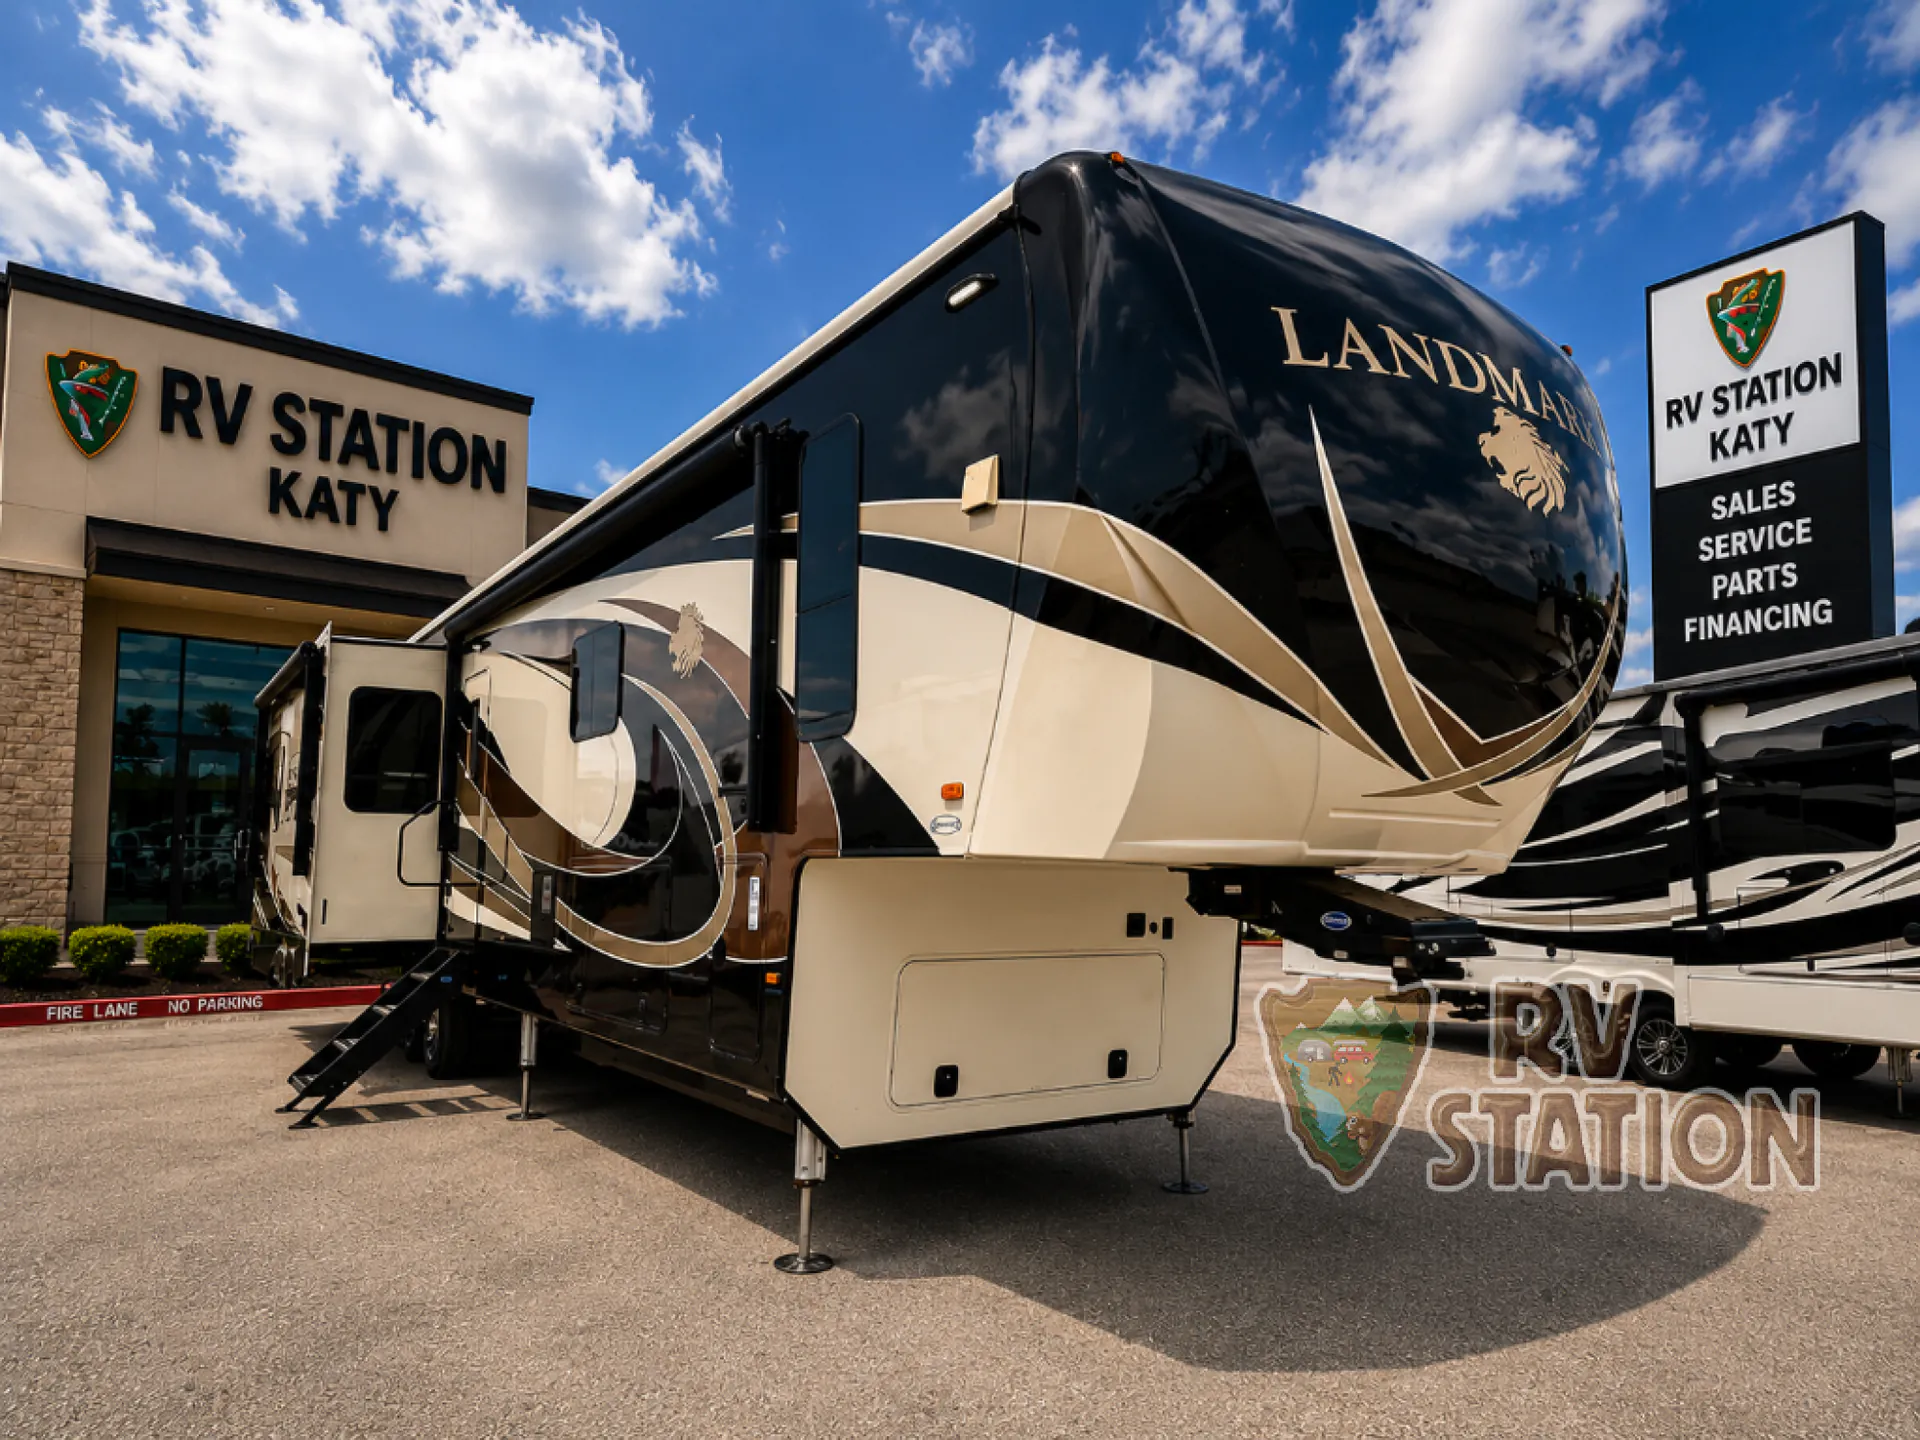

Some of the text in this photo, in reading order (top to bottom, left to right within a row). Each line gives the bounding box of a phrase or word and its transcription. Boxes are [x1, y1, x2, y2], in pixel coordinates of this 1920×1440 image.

[1270, 306, 1602, 458] LANDMARK
[1666, 352, 1843, 429] RV STATION
[159, 366, 507, 494] RV STATION
[1708, 412, 1796, 462] KATY
[268, 466, 400, 532] KATY
[1711, 480, 1796, 521] SALES
[1698, 517, 1813, 562] SERVICE
[1711, 562, 1798, 601] PARTS
[1684, 598, 1833, 643] FINANCING
[46, 995, 264, 1021] FIRE LANE NO PARKING
